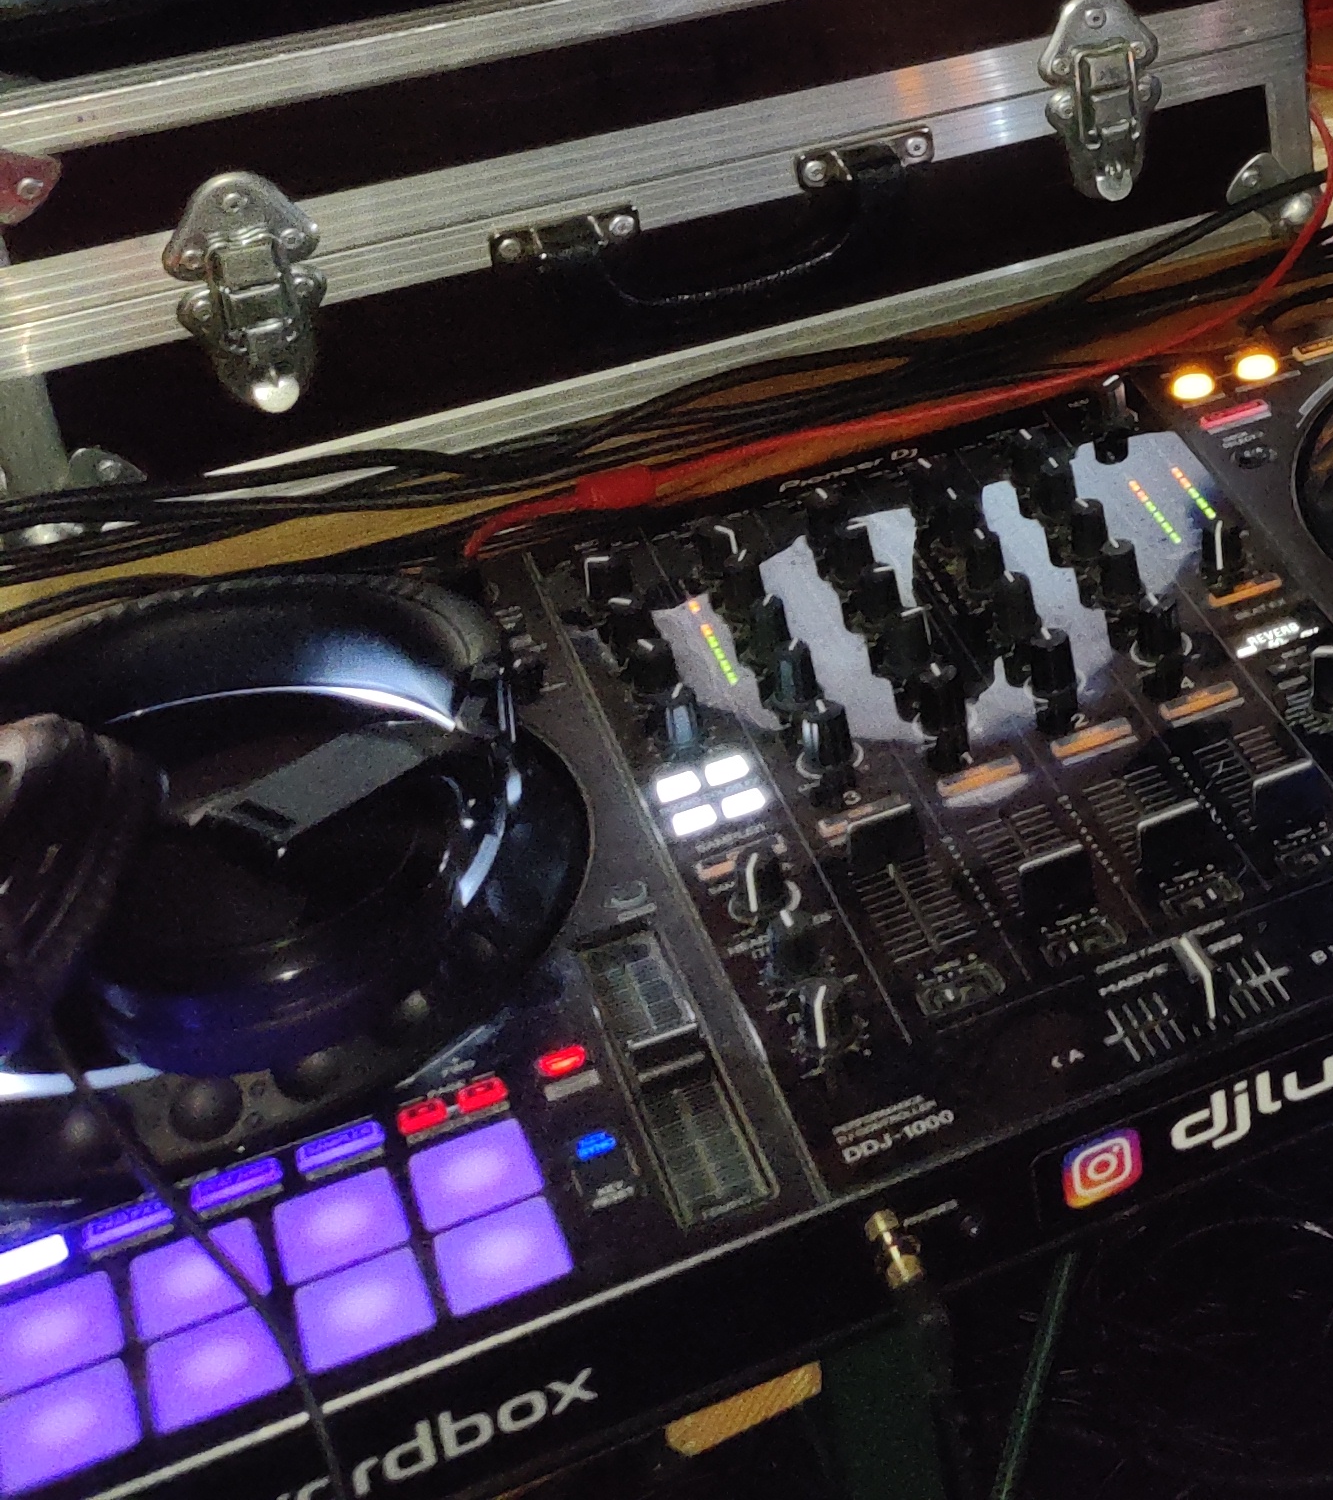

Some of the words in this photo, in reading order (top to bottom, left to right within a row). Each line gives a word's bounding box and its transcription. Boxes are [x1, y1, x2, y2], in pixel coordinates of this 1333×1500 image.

[891, 448, 918, 461] DJ
[1247, 621, 1300, 646] REVERB
[1181, 676, 1195, 689] 4
[1071, 713, 1089, 727] 2
[841, 1109, 955, 1163] DDJ-1000
